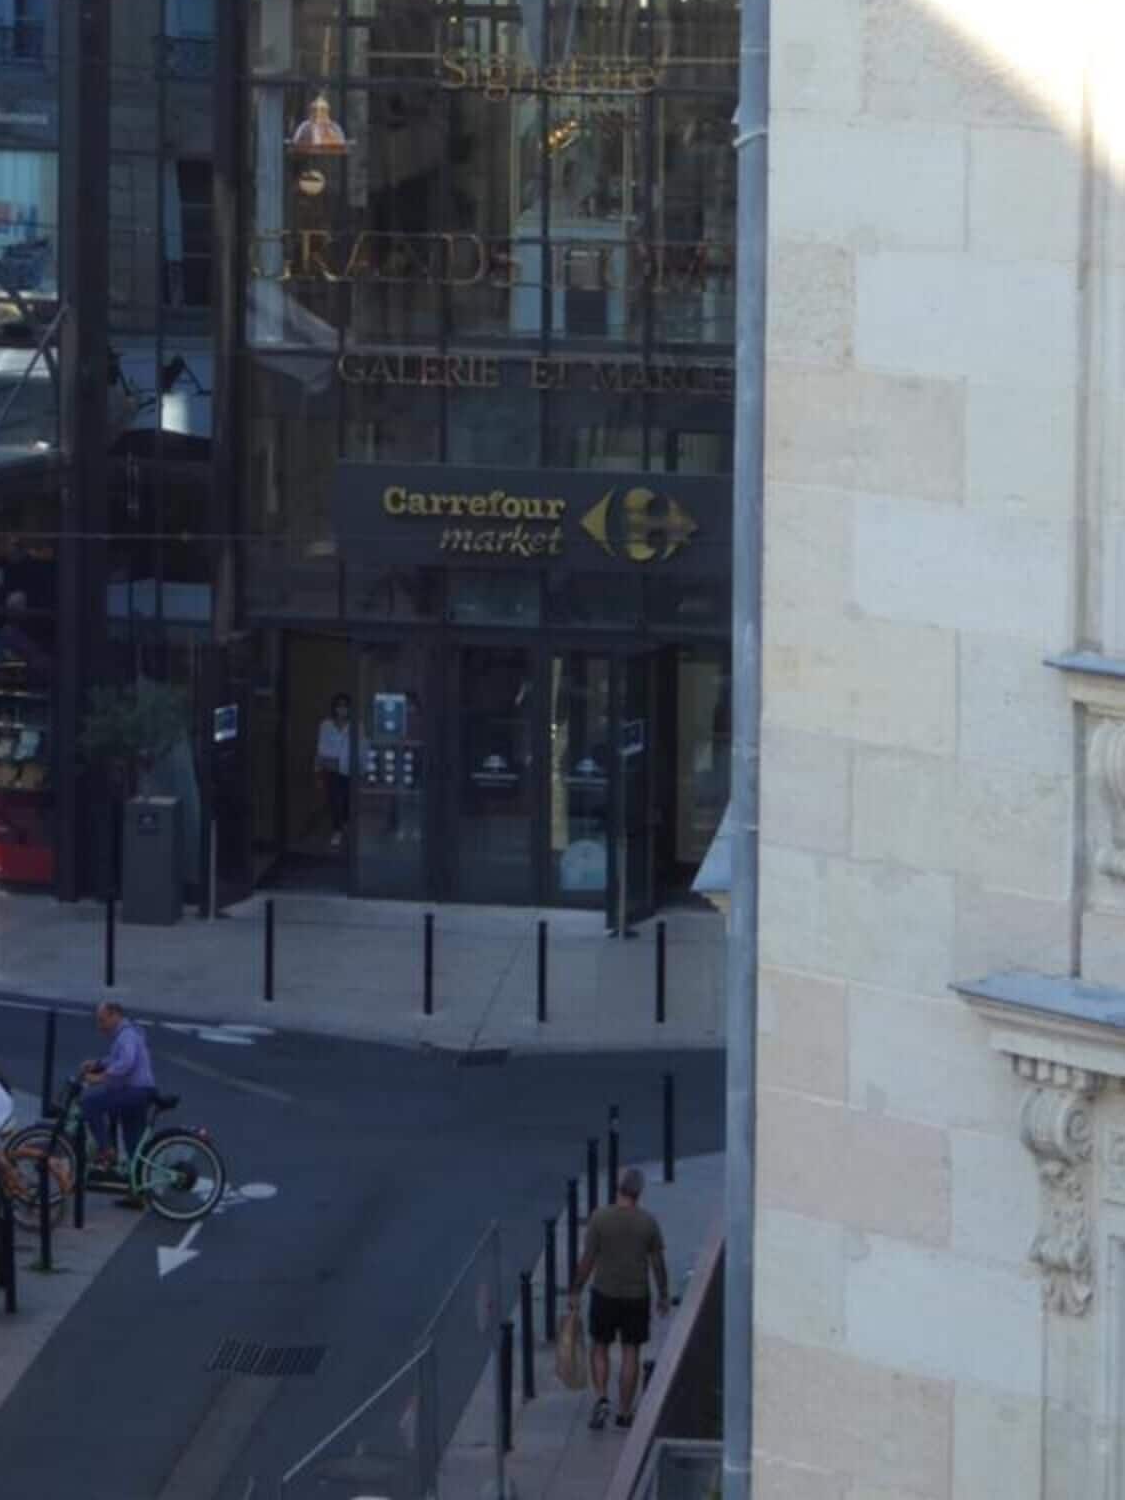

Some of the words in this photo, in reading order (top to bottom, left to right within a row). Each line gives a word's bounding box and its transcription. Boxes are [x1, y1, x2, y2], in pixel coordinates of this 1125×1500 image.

[441, 48, 659, 101] Signature
[337, 354, 502, 389] GALERIE
[382, 485, 567, 520] Carrefour
[439, 524, 564, 558] market
